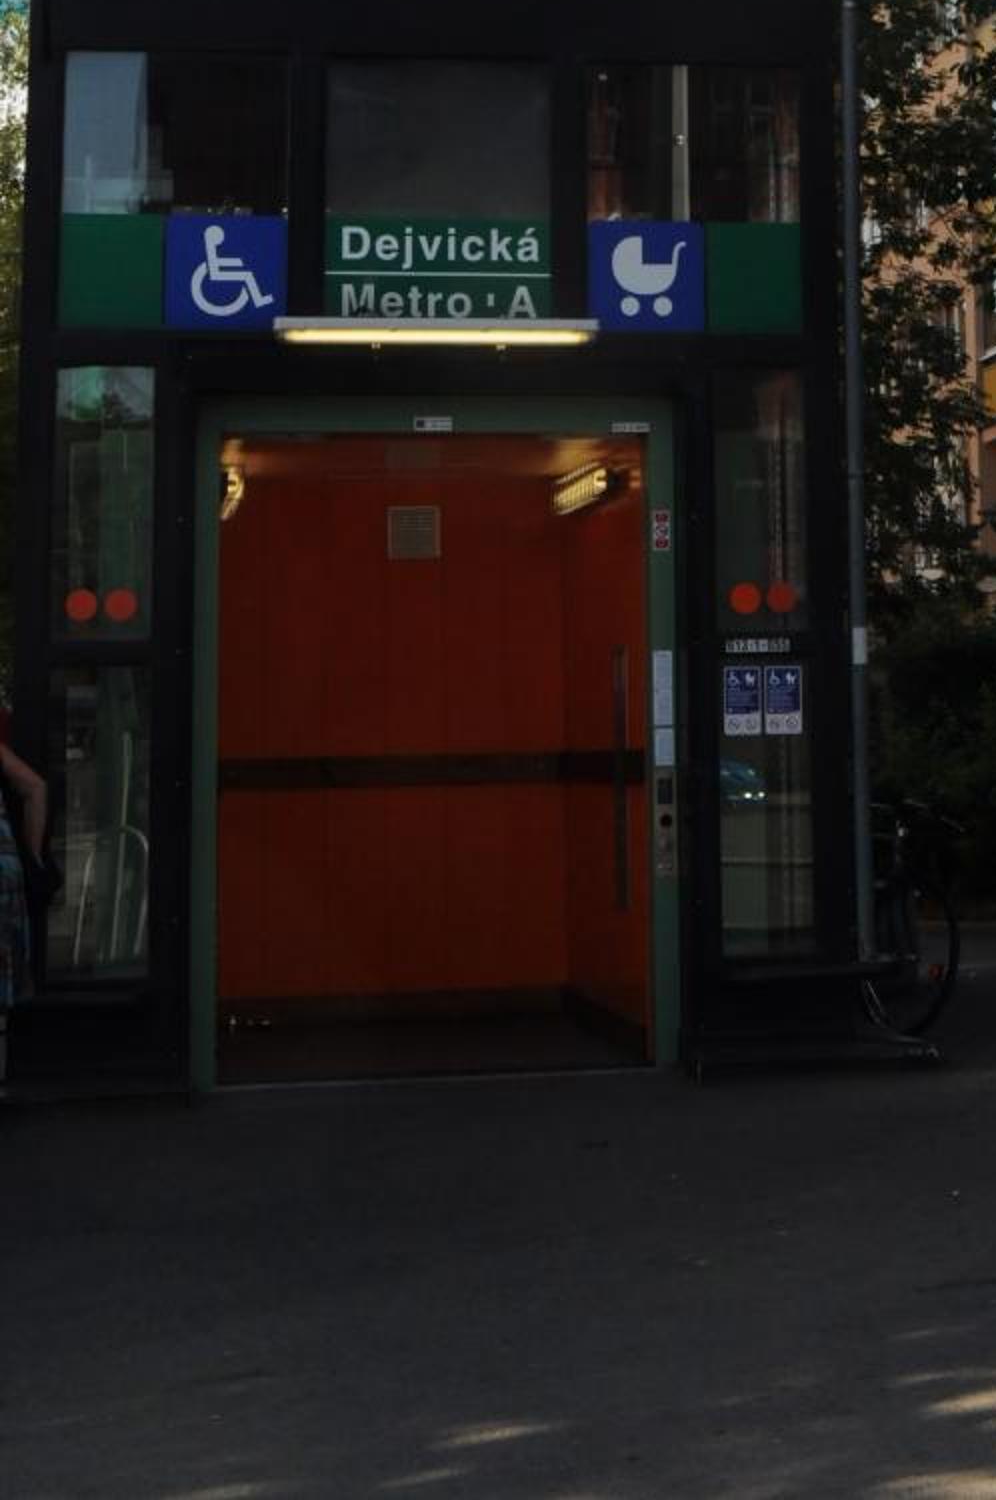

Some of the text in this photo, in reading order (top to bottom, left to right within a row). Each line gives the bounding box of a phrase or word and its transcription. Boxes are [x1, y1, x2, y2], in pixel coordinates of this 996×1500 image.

[341, 226, 540, 270] Dejvická
[341, 283, 472, 318] Metro
[508, 285, 537, 318] A
